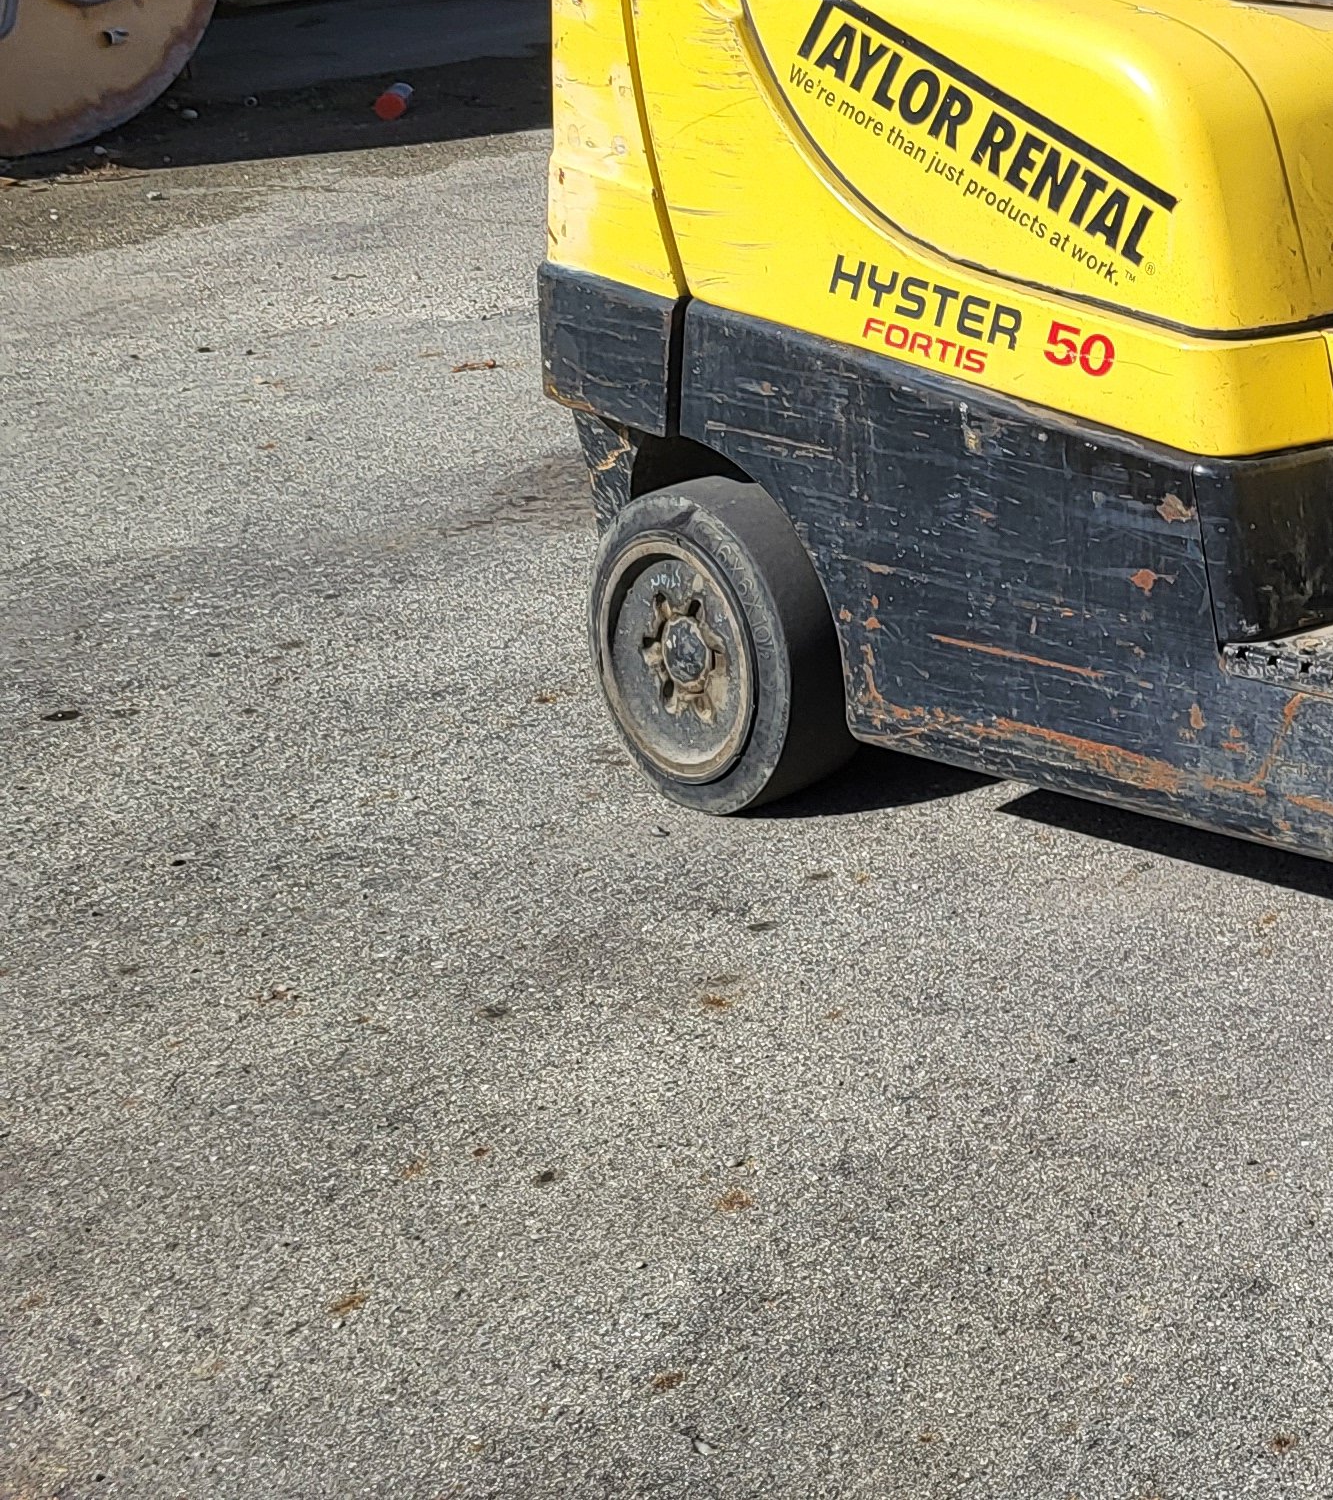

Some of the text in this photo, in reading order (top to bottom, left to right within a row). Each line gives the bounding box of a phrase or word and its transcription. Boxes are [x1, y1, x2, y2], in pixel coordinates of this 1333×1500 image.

[789, 63, 1119, 286] We're more than just products at work.
[971, 110, 1154, 268] RENTAL
[829, 254, 1116, 377] HYSTER 50
[862, 317, 988, 374] FORTIS
